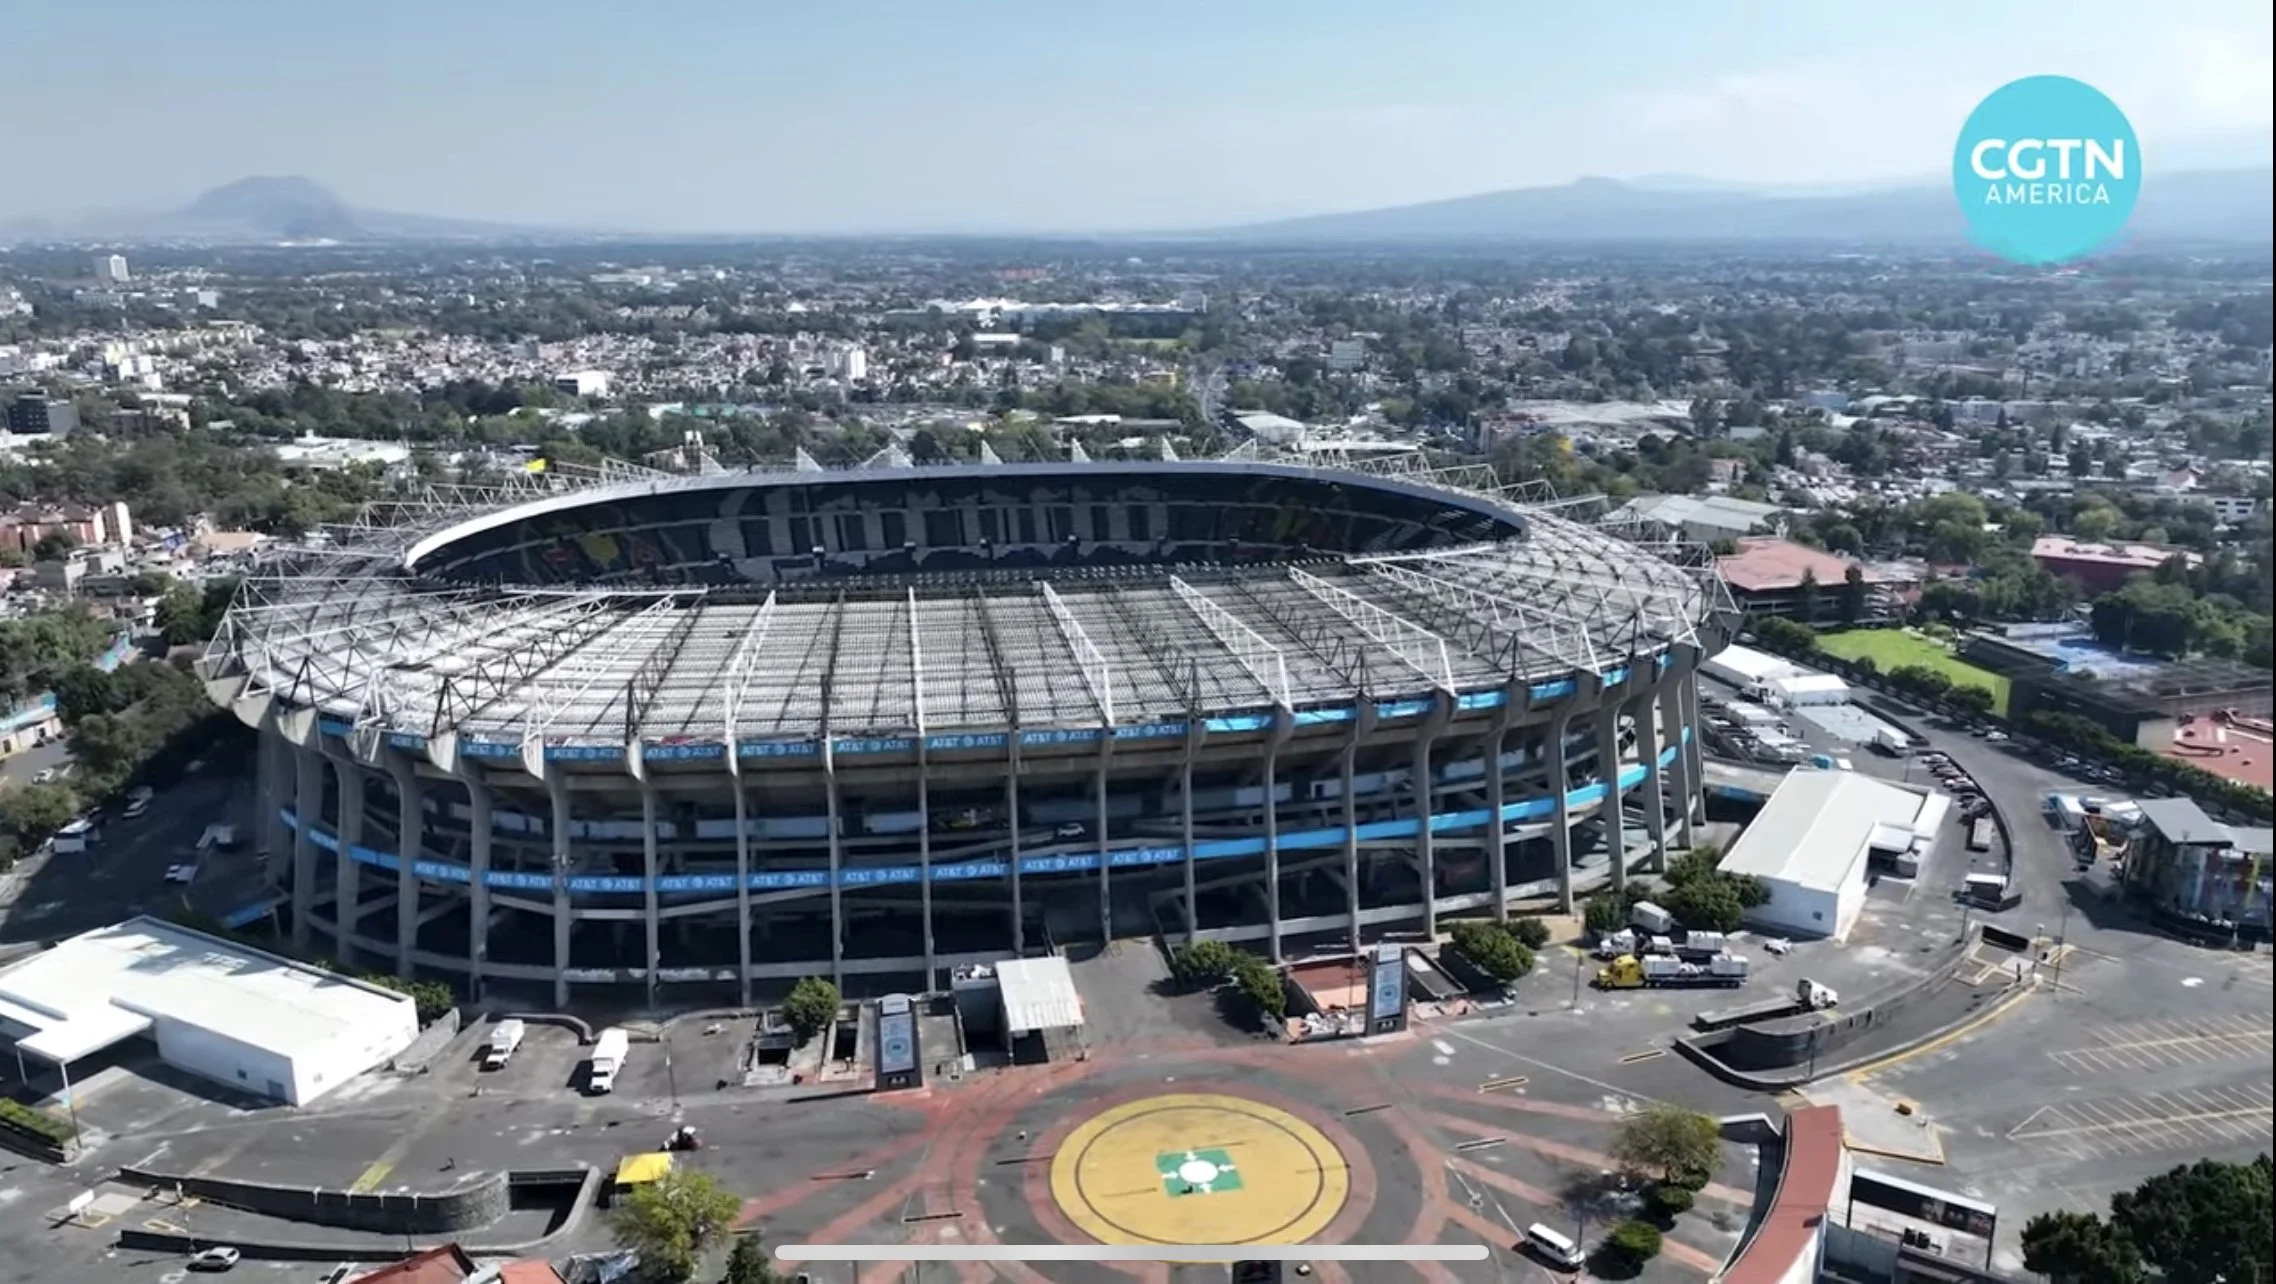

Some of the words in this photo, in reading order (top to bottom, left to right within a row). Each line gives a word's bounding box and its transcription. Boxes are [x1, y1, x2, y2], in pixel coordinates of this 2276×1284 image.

[740, 744, 771, 756] AT&T
[786, 743, 815, 755] AT&T
[837, 741, 864, 752] AT&T
[883, 739, 911, 750] AT&T
[930, 737, 959, 749] AT&T
[976, 734, 1004, 746] AT&T
[1024, 732, 1051, 744] AT&T
[1068, 730, 1095, 741] AT&T
[1115, 727, 1141, 739] AT&T
[1158, 724, 1185, 735] AT&T
[487, 873, 513, 885] AT&T
[570, 878, 597, 890] AT&T
[614, 878, 641, 890] AT&T
[661, 878, 687, 889] AT&T
[705, 876, 733, 887] AT&T
[752, 875, 779, 886] AT&T
[798, 873, 825, 884] AT&T
[845, 871, 871, 882] AT&T
[888, 869, 915, 880] AT&T
[936, 867, 962, 878] AT&T
[979, 864, 1006, 875] AT&T
[1024, 860, 1050, 871] AT&T
[1067, 856, 1093, 867] AT&T
[1112, 854, 1137, 865] AT&T
[1154, 850, 1179, 861] AT&T
